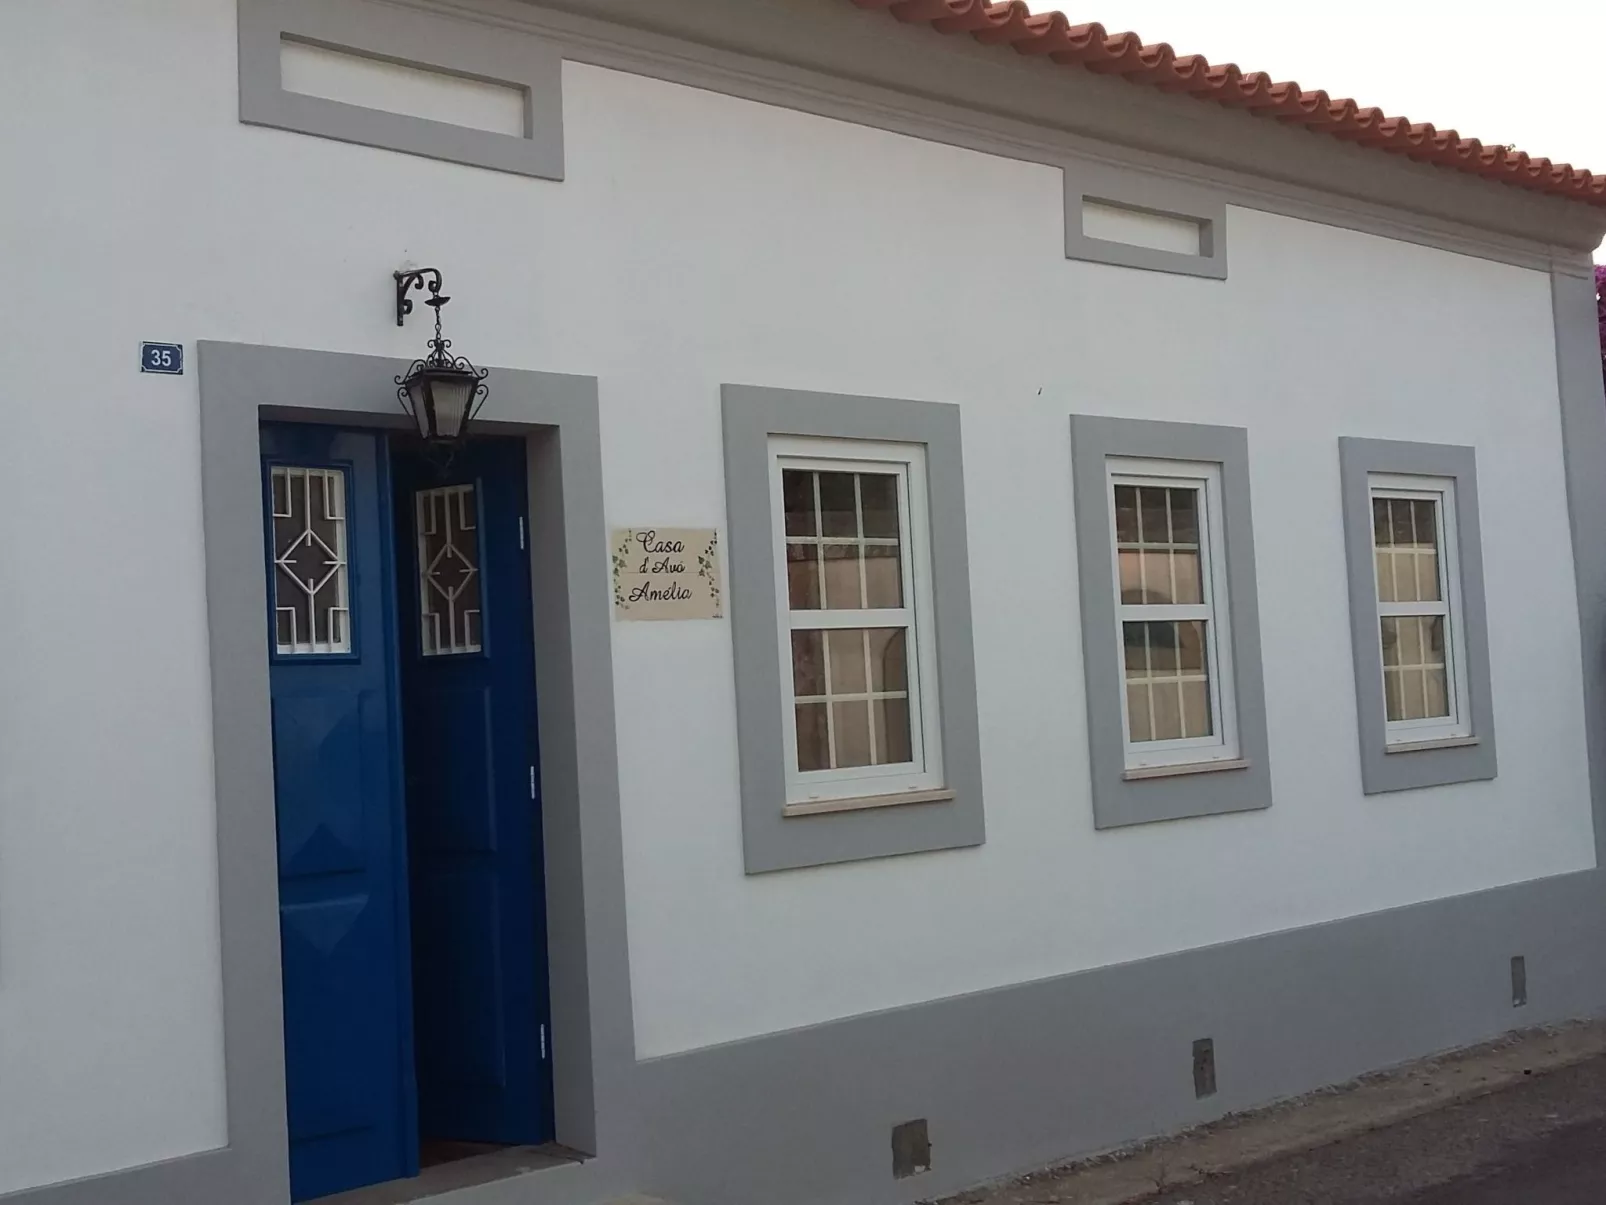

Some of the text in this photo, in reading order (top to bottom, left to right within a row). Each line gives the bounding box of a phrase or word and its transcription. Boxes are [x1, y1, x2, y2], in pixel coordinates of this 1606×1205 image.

[151, 349, 171, 366] 35
[636, 530, 685, 553] Casa
[628, 581, 693, 602] Amélia
